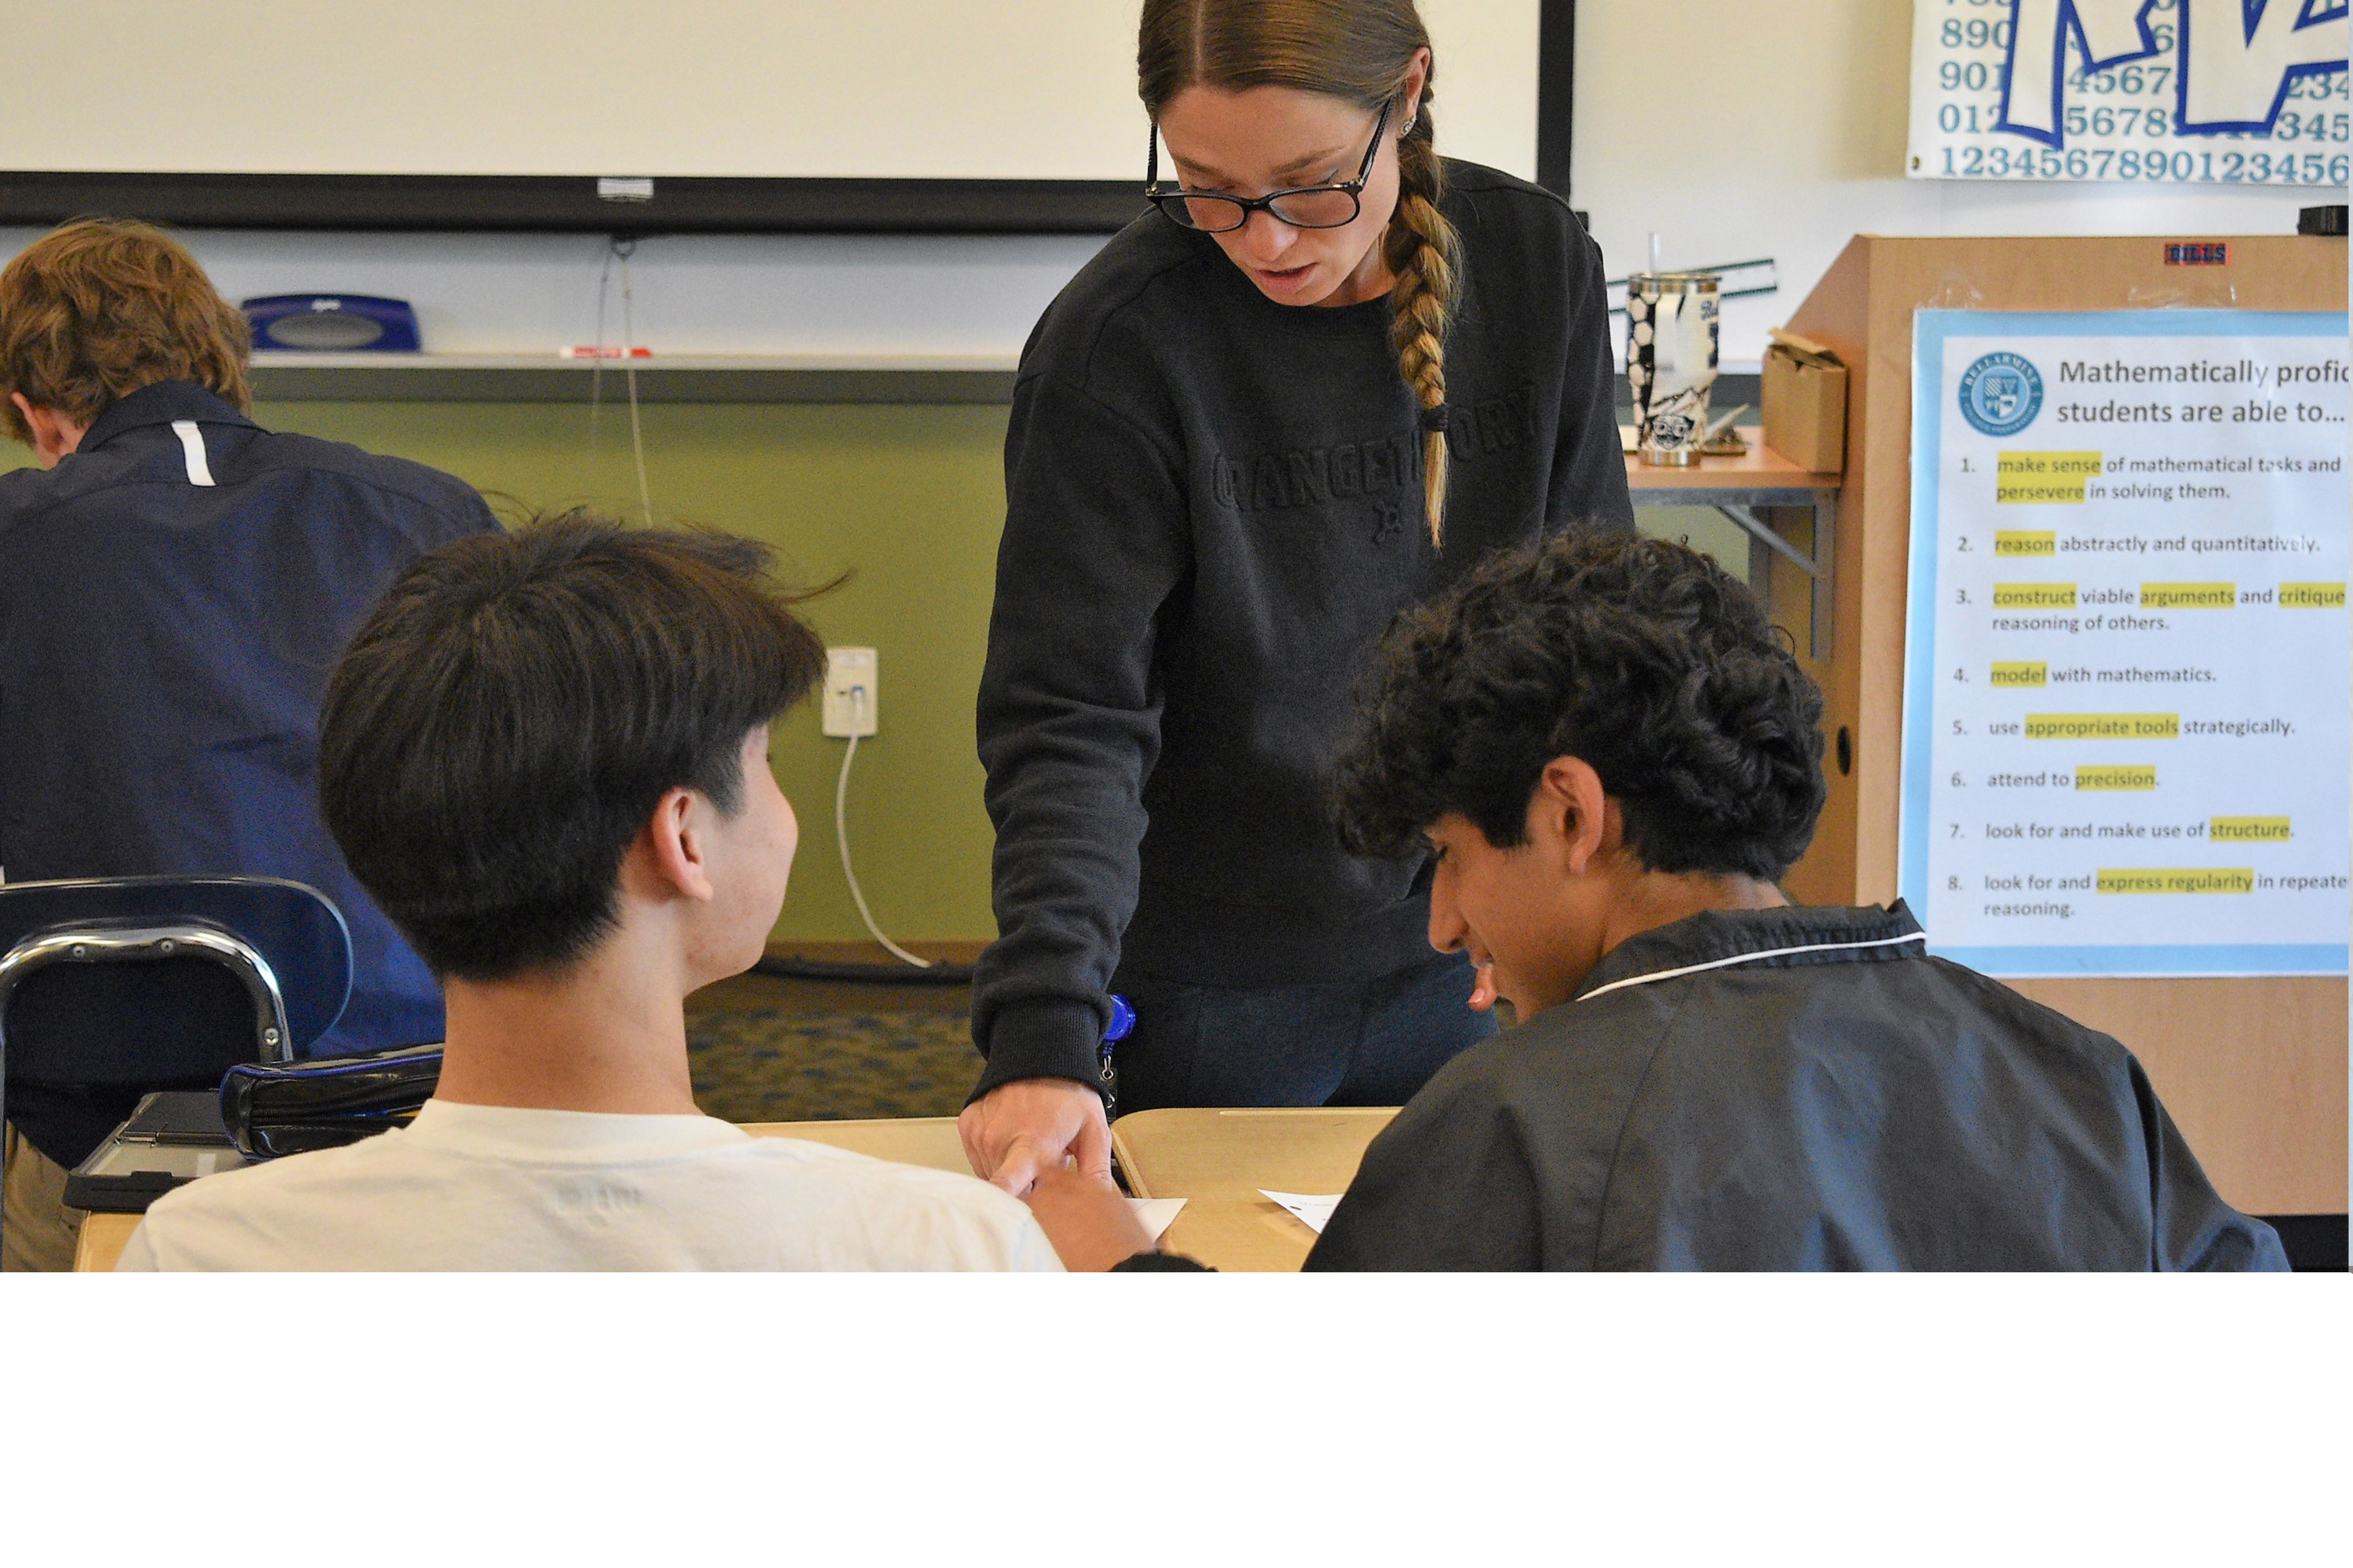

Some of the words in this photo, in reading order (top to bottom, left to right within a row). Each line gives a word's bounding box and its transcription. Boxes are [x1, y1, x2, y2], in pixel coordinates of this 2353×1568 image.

[2060, 360, 2268, 388] Mathematically
[2058, 399, 2172, 422] students
[2181, 406, 2223, 422] are
[2232, 399, 2287, 422] able
[2296, 402, 2345, 422] to...
[1961, 457, 1975, 473] 1.
[1997, 457, 2046, 473] make
[2051, 461, 2101, 473] sense
[2106, 457, 2125, 472] of
[2130, 457, 2252, 472] mathematical
[2258, 457, 2302, 472] tasks
[2308, 457, 2341, 472] and
[1997, 487, 2084, 502] persevere
[2090, 484, 2106, 498] in
[2112, 483, 2173, 502] solving
[2179, 483, 2230, 498] them.
[1957, 536, 1972, 552] 2.
[1995, 540, 2055, 552] reason
[2060, 536, 2147, 554] abstractly
[2153, 536, 2186, 551] and
[2191, 536, 2320, 554] quantitatively.
[1957, 589, 1971, 604] 3.
[1993, 590, 2076, 605] construct
[2081, 588, 2134, 604] viable
[2140, 590, 2235, 608] arguments
[2240, 588, 2273, 604] and
[2278, 588, 2345, 606] critique
[1992, 615, 2079, 634] reasoning
[2085, 614, 2103, 630] of
[2108, 614, 2169, 630] others.
[1953, 668, 1968, 682] 4.
[1991, 667, 2046, 683] model
[2051, 667, 2091, 682] with
[2097, 667, 2216, 682] mathematics.
[1953, 720, 1967, 735] 5.
[1989, 723, 2019, 735] use
[2025, 720, 2130, 738] appropriate
[2135, 719, 2178, 735] tools
[2184, 718, 2295, 738] strategically.
[1951, 772, 1966, 787] 6.
[1987, 772, 2046, 787] attend
[2051, 773, 2070, 787] to
[2075, 772, 2160, 790] precision.
[1950, 823, 1964, 838] 7.
[1986, 823, 2023, 839] look
[2029, 822, 2054, 839] for
[2059, 823, 2093, 838] and
[2098, 823, 2145, 838] make
[2151, 826, 2181, 838] use
[2187, 821, 2205, 838] of
[2210, 824, 2294, 838] structure.
[1948, 875, 1962, 890] 8.
[1985, 875, 2022, 890] look
[2027, 874, 2052, 890] for
[2058, 875, 2091, 889] and
[2096, 878, 2162, 892] express
[2168, 873, 2253, 892] regularity
[2258, 873, 2274, 889] in
[2280, 875, 2349, 892] repeate
[1984, 901, 2074, 919] reasoning.
